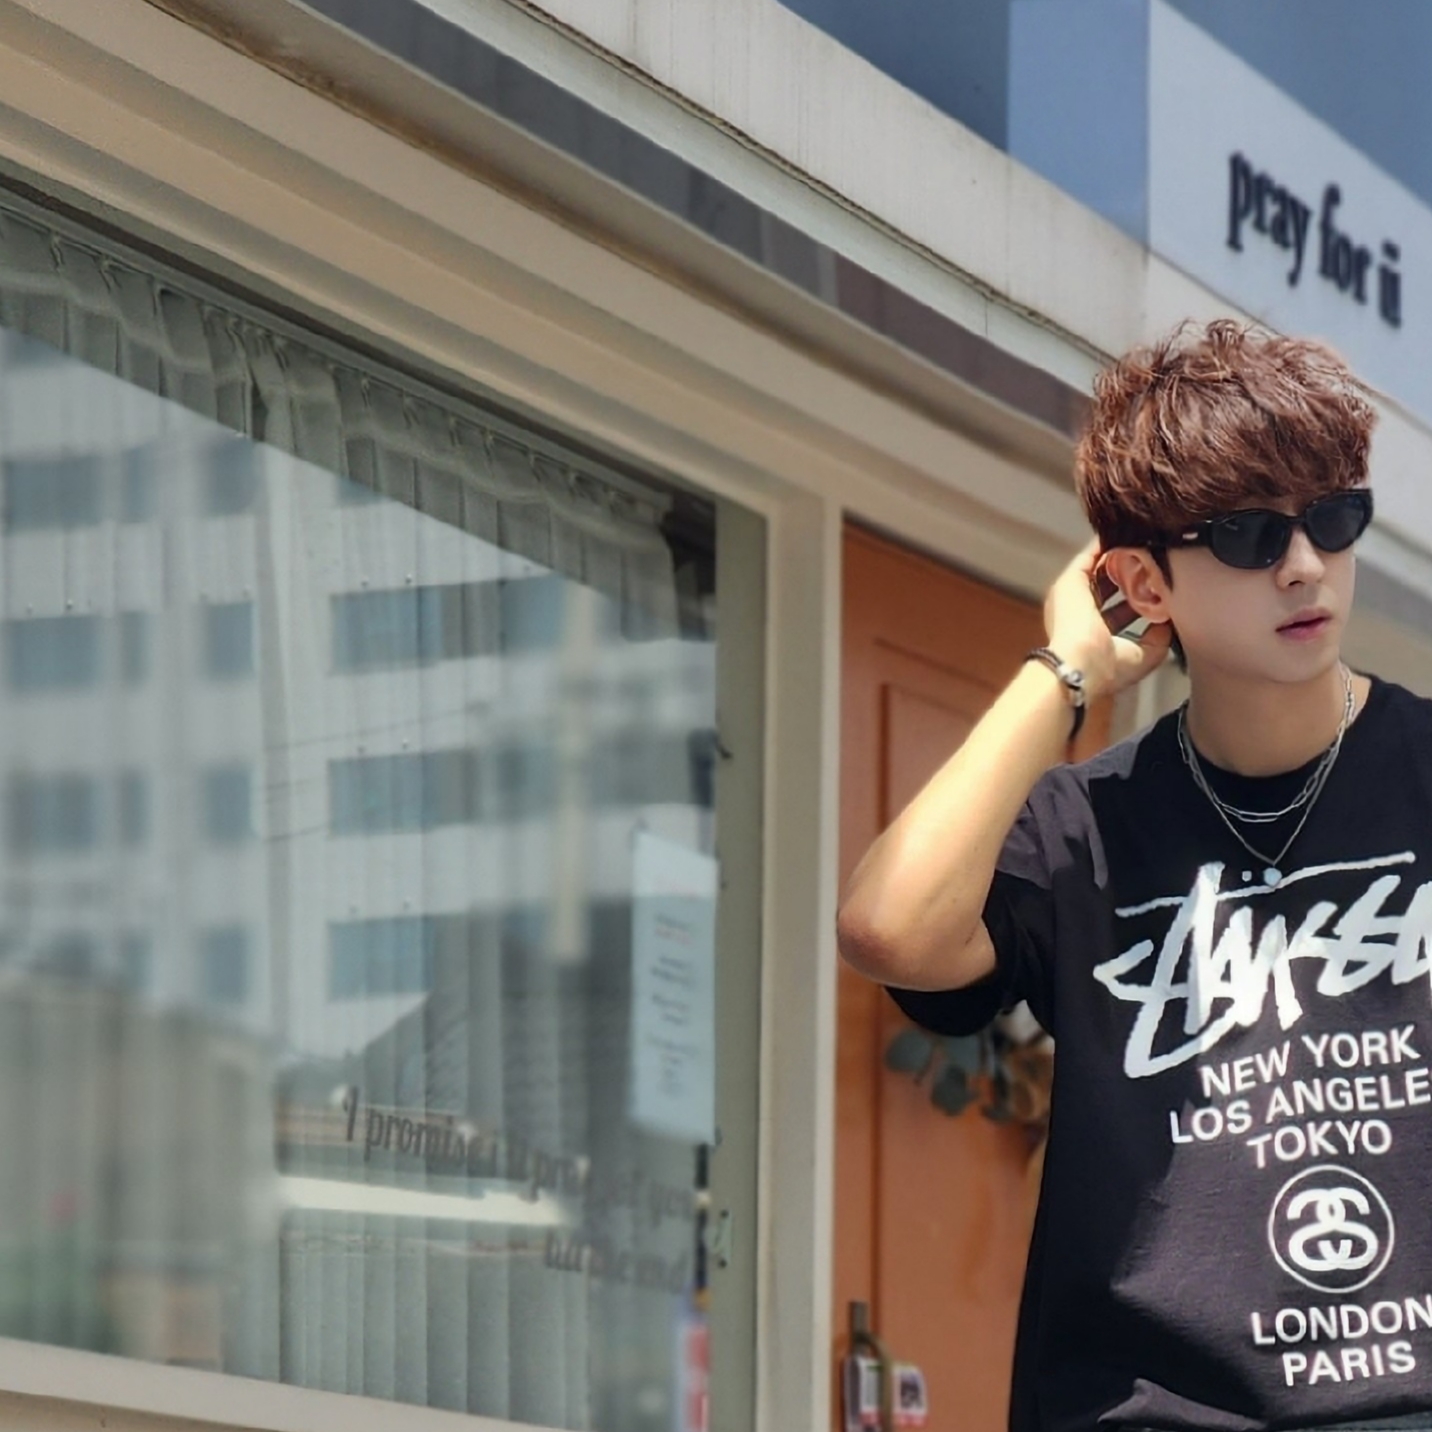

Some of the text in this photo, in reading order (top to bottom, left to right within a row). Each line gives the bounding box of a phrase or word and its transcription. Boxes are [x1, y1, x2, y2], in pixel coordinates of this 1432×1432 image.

[1226, 151, 1312, 288] pray
[1317, 182, 1373, 306] for
[1199, 1024, 1421, 1098] NEW YORK
[1169, 1099, 1254, 1144] LOS
[1245, 1119, 1393, 1169] TOKYO
[1281, 1339, 1417, 1387] PARIS
